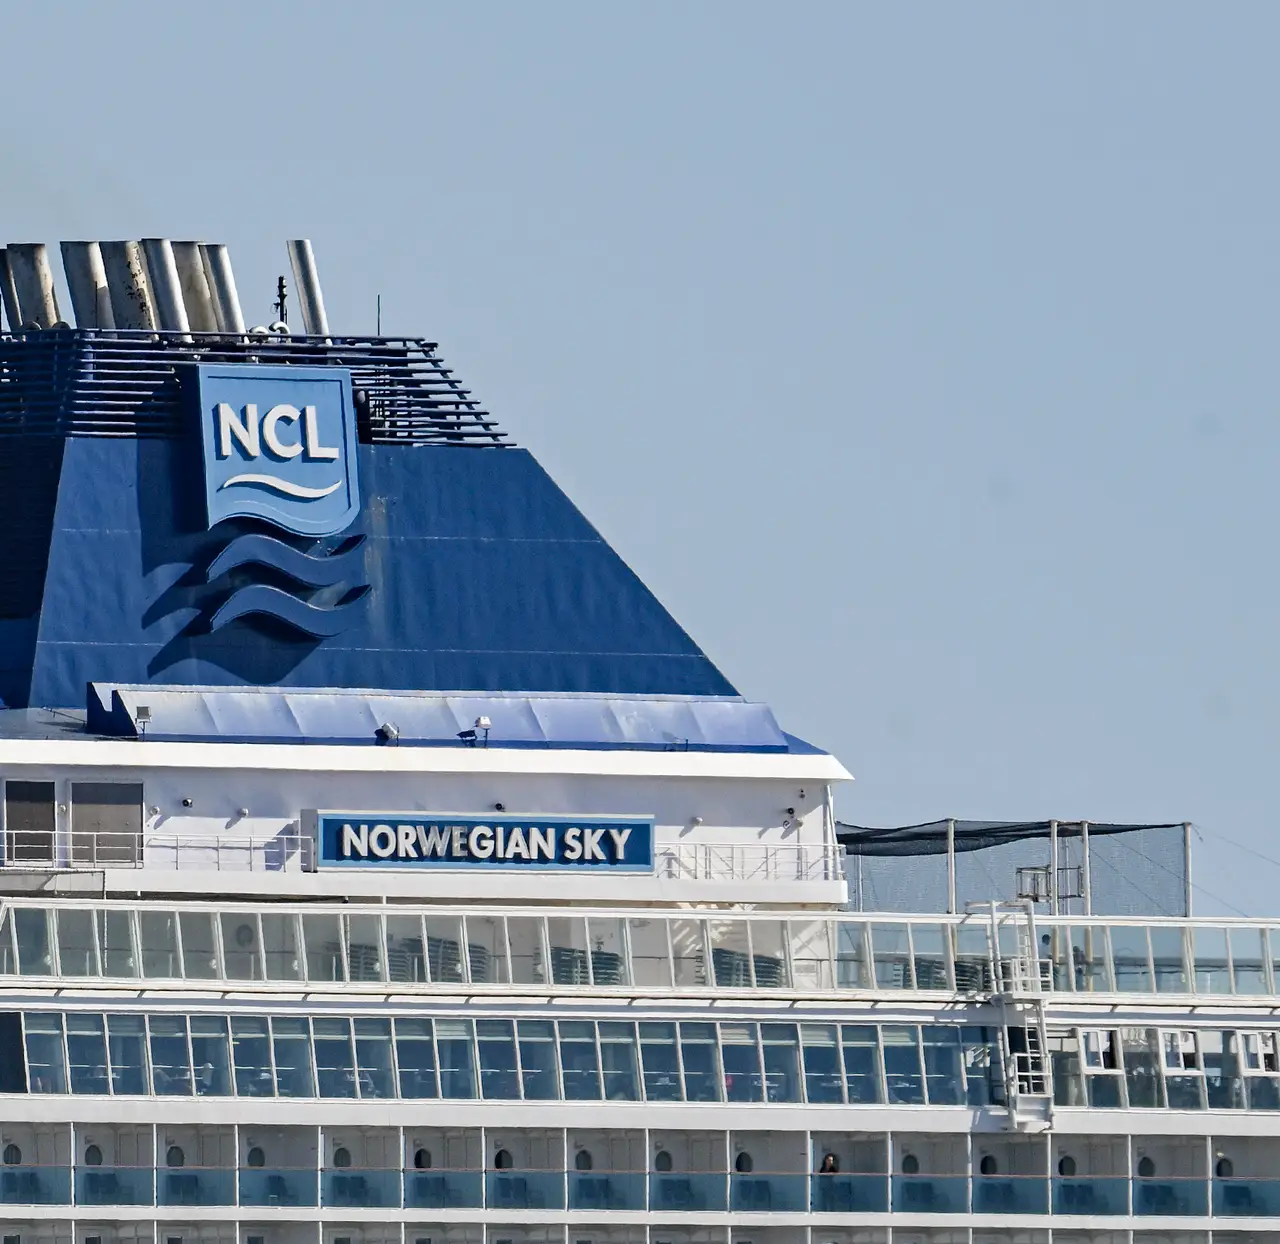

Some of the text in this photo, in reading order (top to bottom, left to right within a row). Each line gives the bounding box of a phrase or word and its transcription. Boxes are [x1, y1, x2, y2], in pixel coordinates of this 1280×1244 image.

[218, 403, 340, 459] NCL
[342, 823, 633, 860] NORWEGIAN SKY
